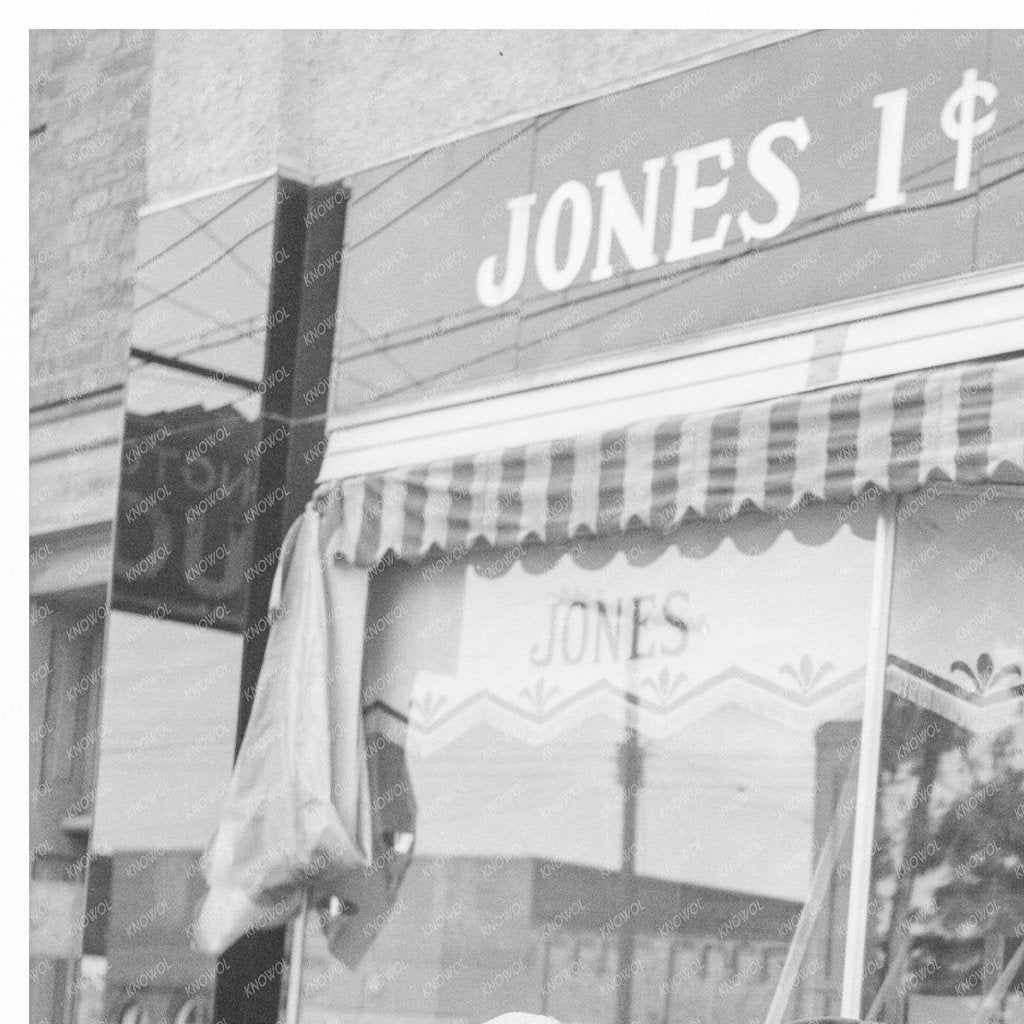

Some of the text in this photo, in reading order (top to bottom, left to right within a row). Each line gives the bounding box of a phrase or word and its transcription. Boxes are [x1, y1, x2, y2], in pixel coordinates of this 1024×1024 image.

[475, 116, 811, 308] JONES
[866, 68, 998, 213] 1¢
[530, 589, 690, 667] JONES
